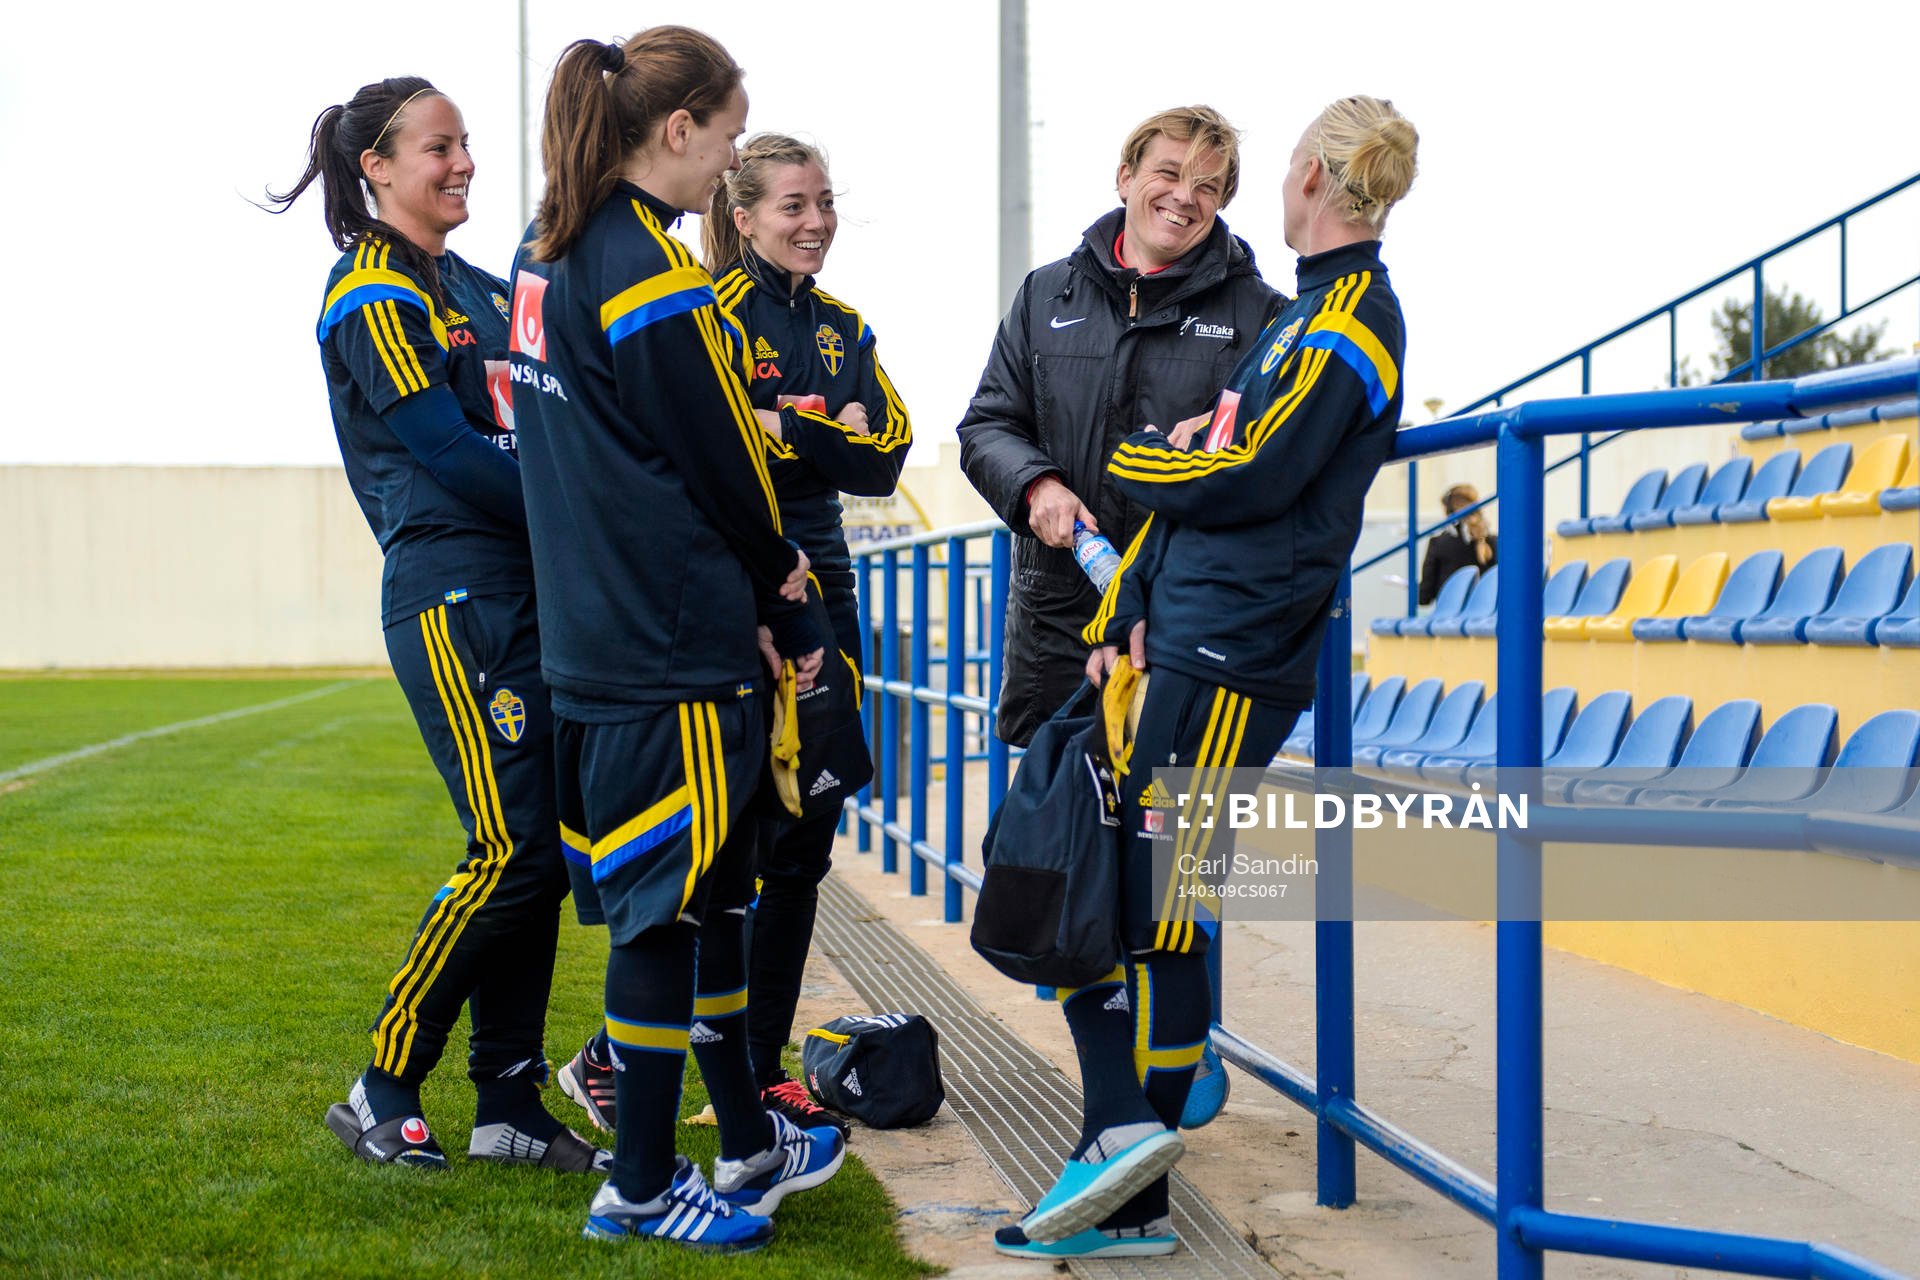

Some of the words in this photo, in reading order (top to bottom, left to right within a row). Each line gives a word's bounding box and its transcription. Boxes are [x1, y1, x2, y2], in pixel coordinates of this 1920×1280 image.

[752, 361, 783, 380] ICA
[809, 779, 841, 797] adidas
[850, 1067, 863, 1097] adidas
